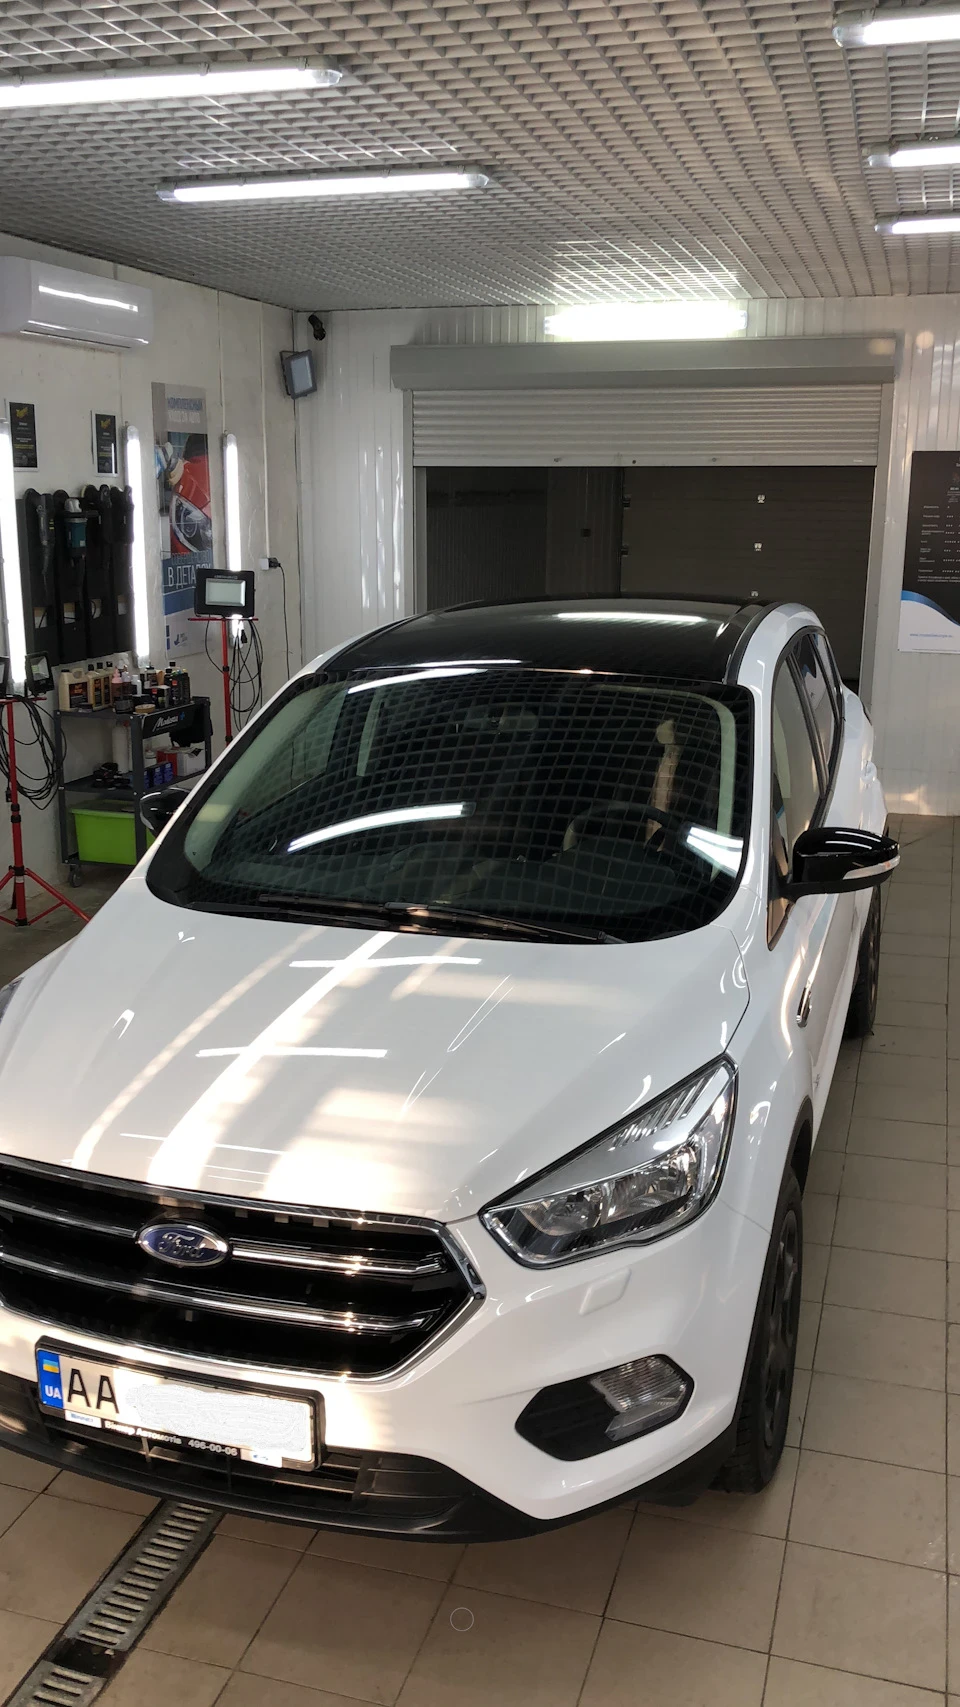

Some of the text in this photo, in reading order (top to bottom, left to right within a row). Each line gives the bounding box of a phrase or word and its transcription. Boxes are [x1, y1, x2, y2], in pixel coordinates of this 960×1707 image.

[168, 566, 174, 587] В
[159, 1232, 205, 1258] Ford
[45, 1384, 62, 1400] UA
[67, 1368, 120, 1414] AA
